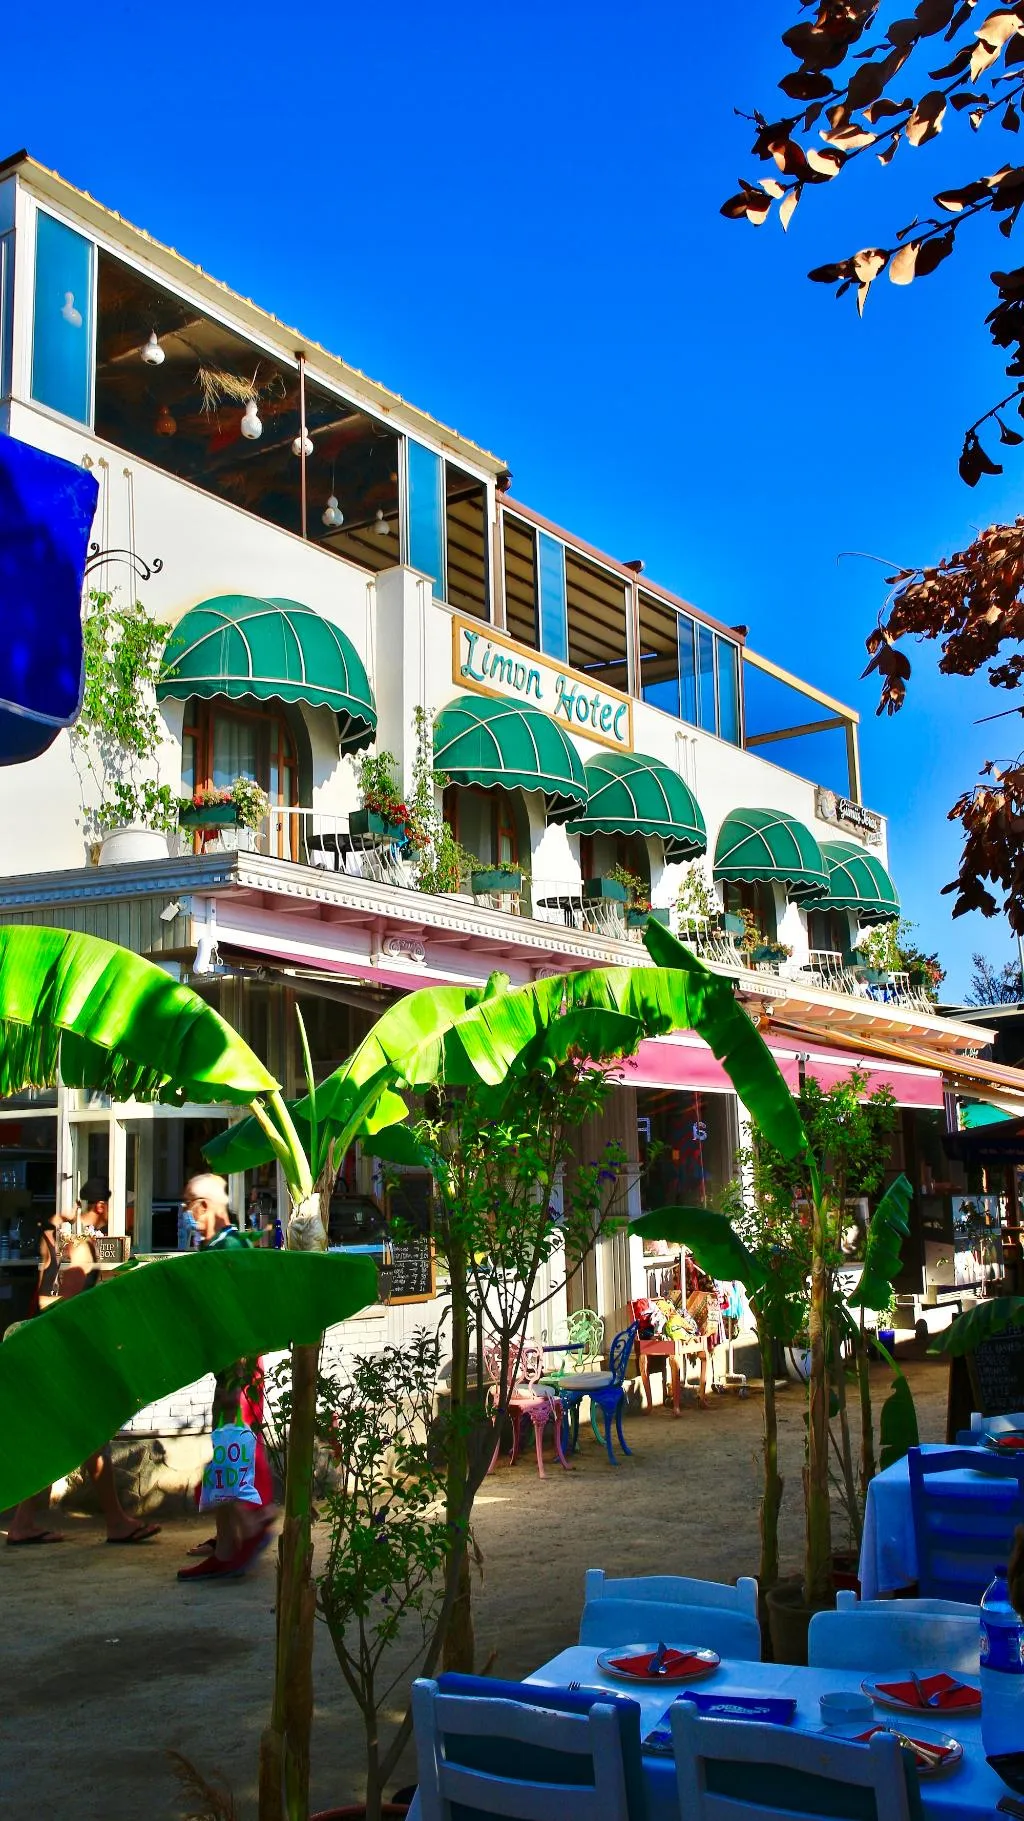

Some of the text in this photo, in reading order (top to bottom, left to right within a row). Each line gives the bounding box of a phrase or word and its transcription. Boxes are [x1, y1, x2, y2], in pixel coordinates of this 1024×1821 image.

[461, 630, 627, 741] Limon Hotel
[213, 1443, 250, 1465] OOL
[202, 1467, 249, 1489] KIDZ
